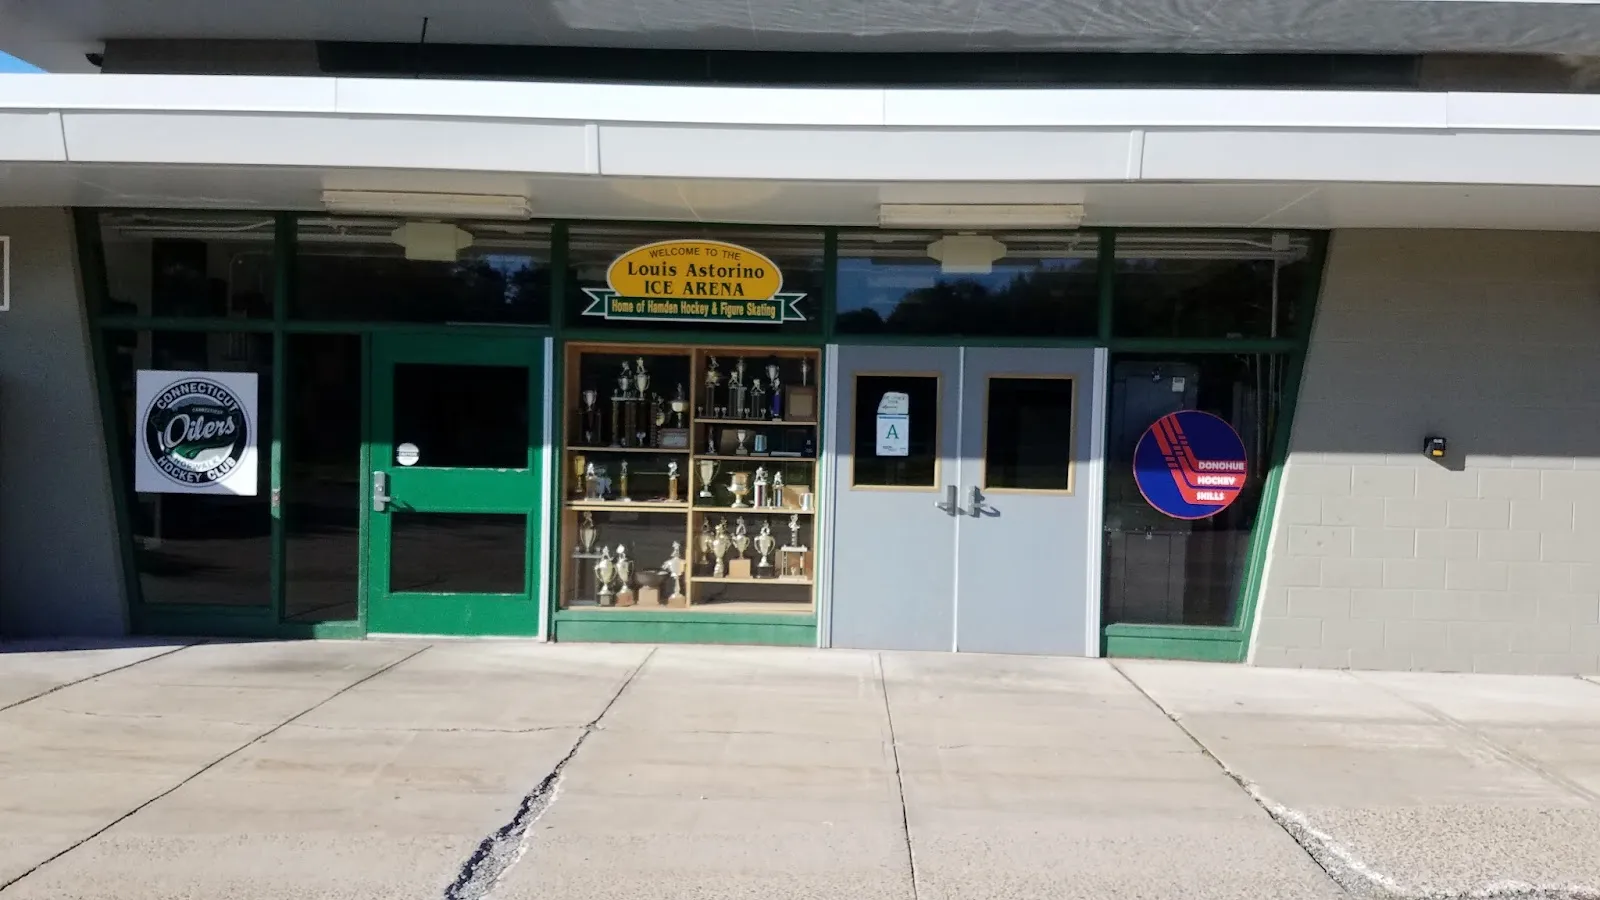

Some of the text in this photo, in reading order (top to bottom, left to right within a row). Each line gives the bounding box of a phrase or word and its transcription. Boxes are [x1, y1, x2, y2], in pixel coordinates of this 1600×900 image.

[650, 247, 741, 260] WELCOME TO THE
[627, 261, 765, 279] Louis Astorino
[645, 280, 745, 297] ICE ARENA
[611, 299, 776, 319] Home of Hamden Hockey & Figure Skating
[157, 383, 238, 412] CONNECTICUT
[164, 414, 235, 448] Oilers
[885, 424, 900, 439] A
[158, 456, 236, 482] HOCKEY CLUB
[1198, 461, 1244, 470] DONOHUE
[1197, 475, 1236, 486] HOCKEY
[1196, 491, 1225, 501] SKILLS
